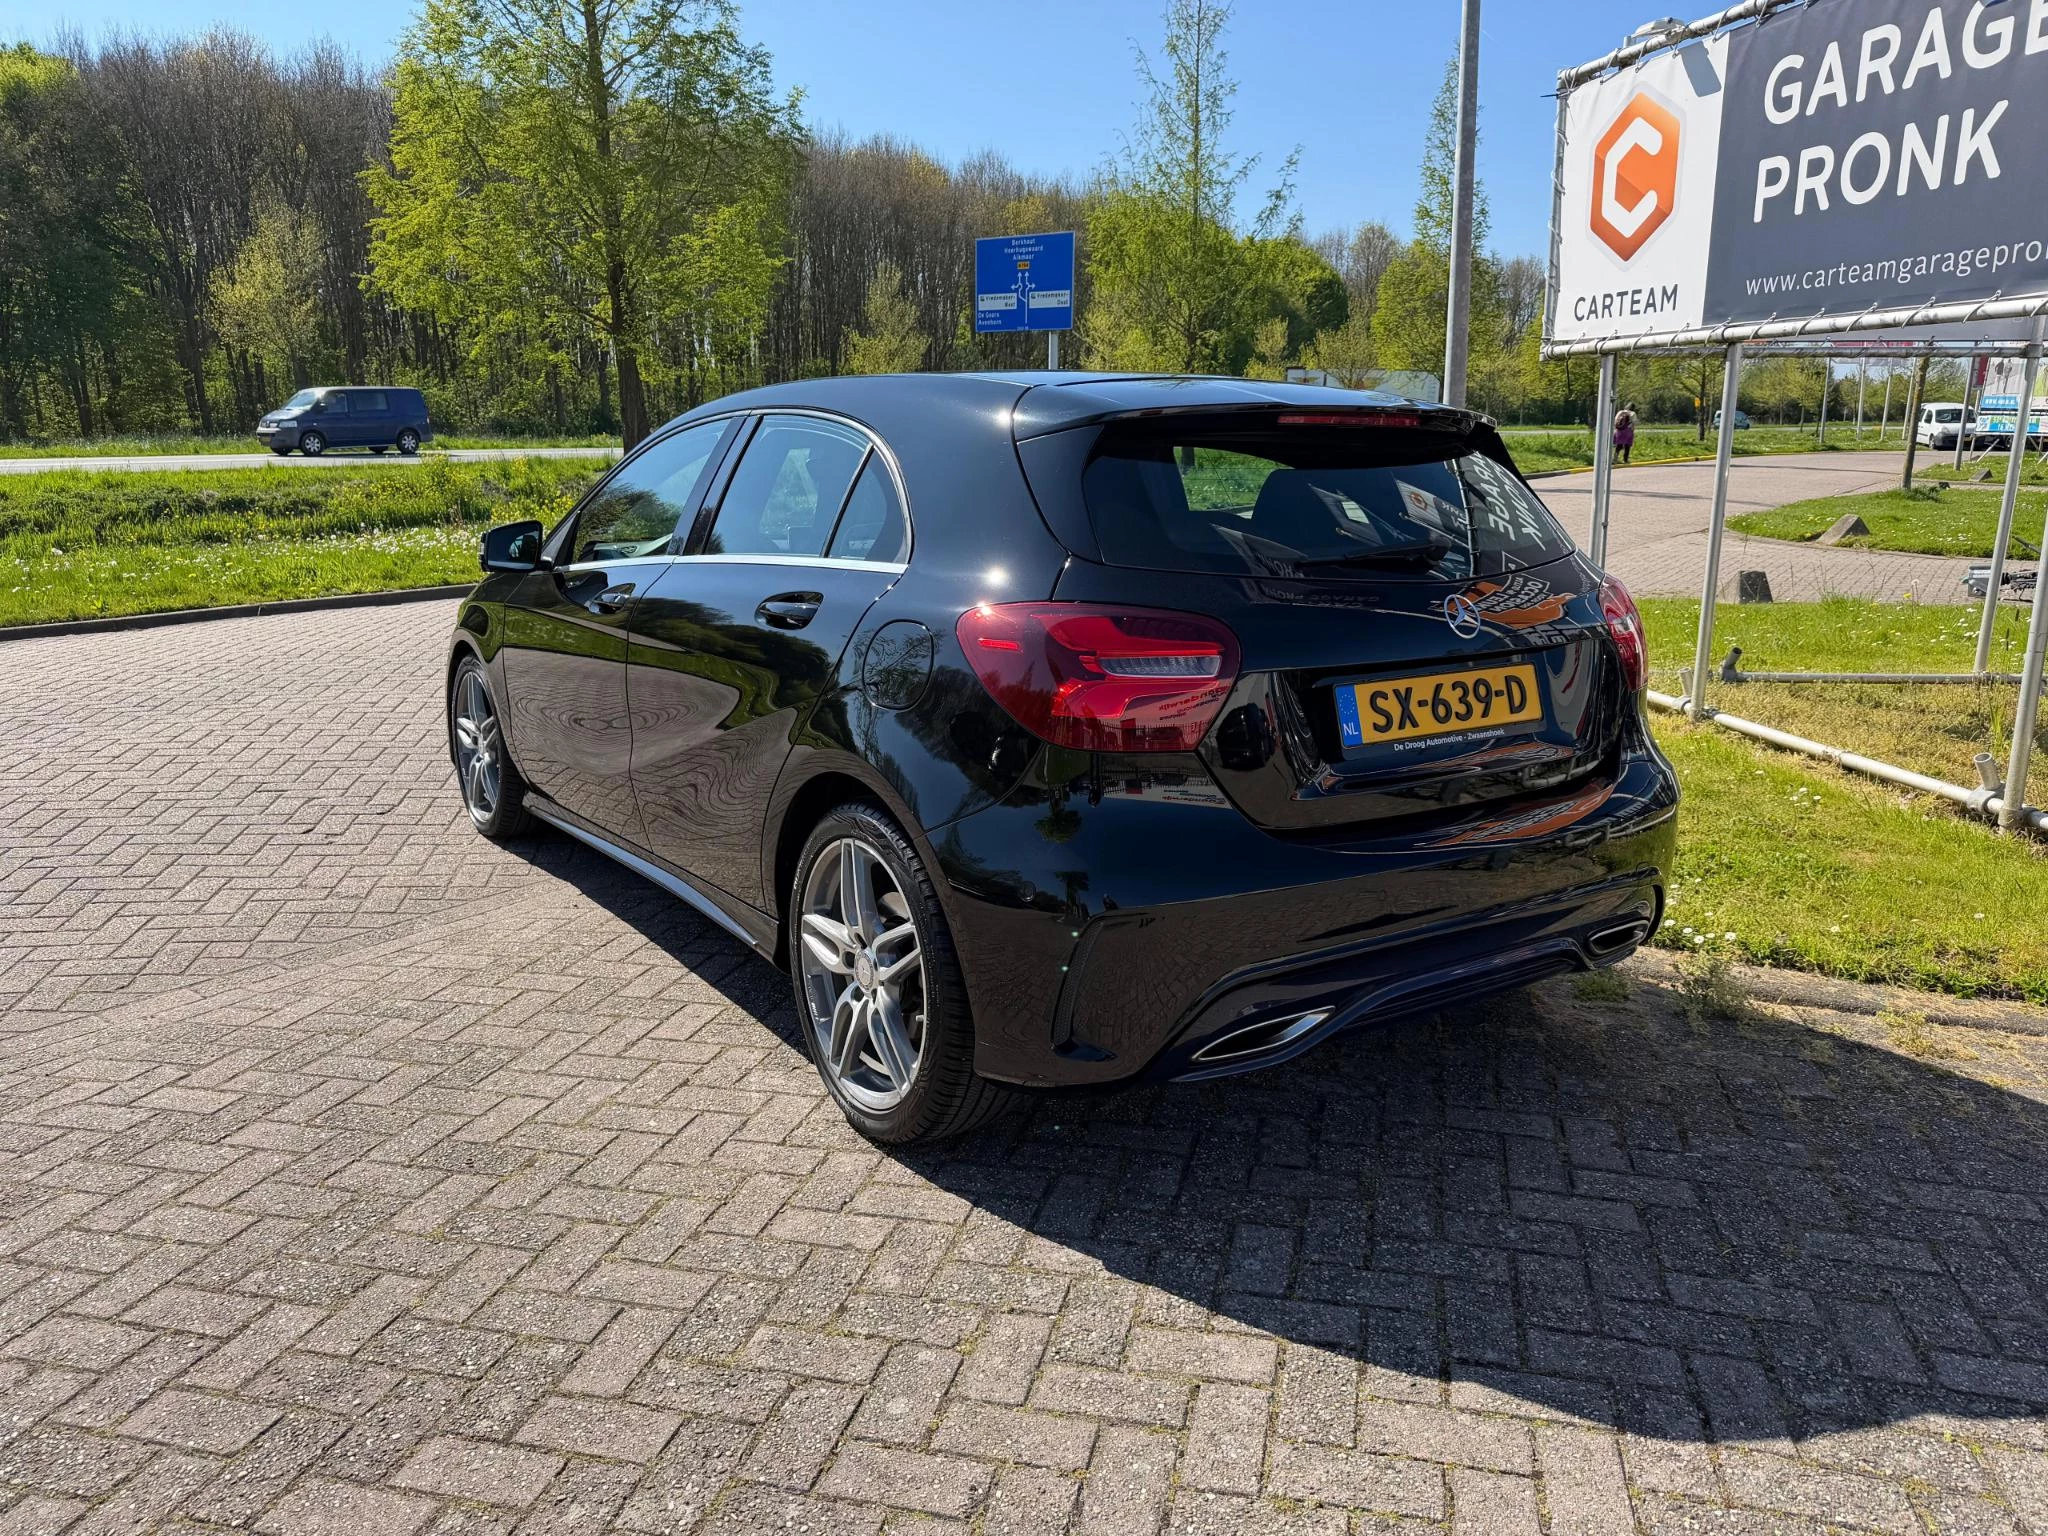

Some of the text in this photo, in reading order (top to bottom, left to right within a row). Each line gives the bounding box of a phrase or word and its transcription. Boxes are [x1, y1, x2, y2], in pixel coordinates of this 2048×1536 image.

[1764, 0, 2048, 125] GARAGE
[1753, 99, 2009, 223] PRONK
[1745, 240, 2048, 296] www.carteamgaragepro
[1574, 283, 1679, 322] CARTEAM
[1343, 723, 1359, 736] NL
[1369, 674, 1528, 734] SX-639-D
[1394, 743, 1404, 751] De
[1405, 739, 1426, 751] Droog
[1426, 734, 1463, 746] Automotive
